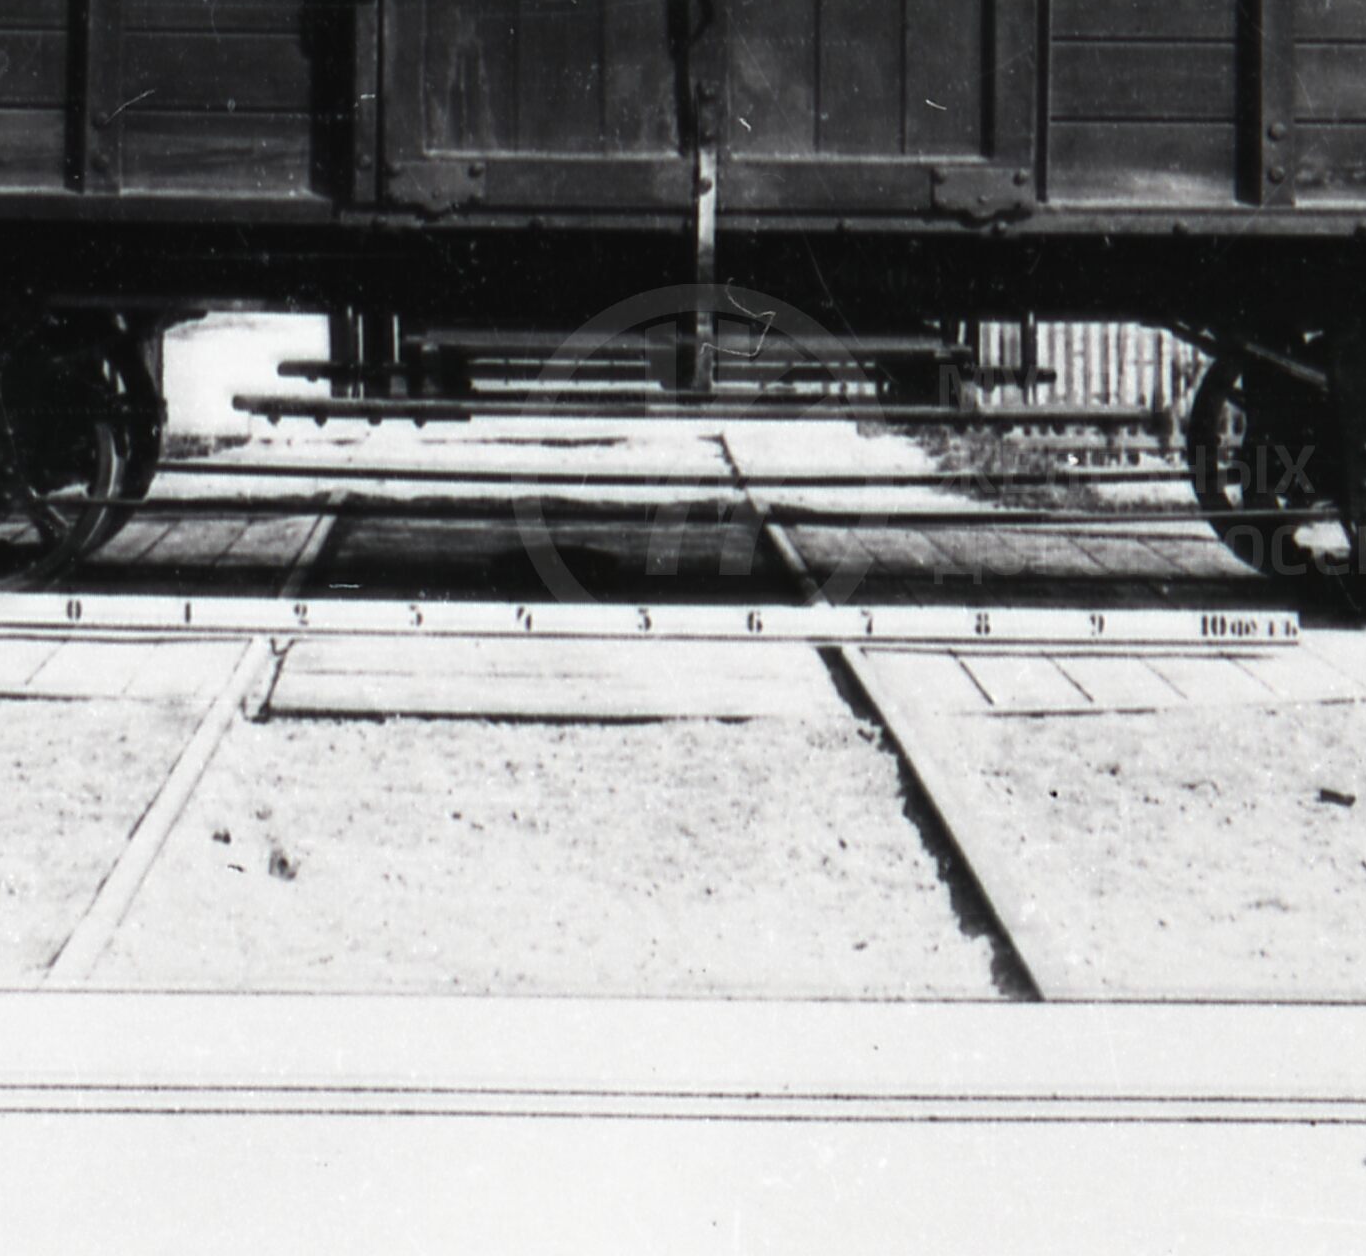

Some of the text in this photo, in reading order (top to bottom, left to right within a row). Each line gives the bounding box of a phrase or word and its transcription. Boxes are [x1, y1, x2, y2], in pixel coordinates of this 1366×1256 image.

[65, 599, 82, 622] 0
[292, 603, 310, 626] 2
[746, 610, 763, 634] 6
[974, 612, 991, 637] 8
[1089, 613, 1105, 637] 9
